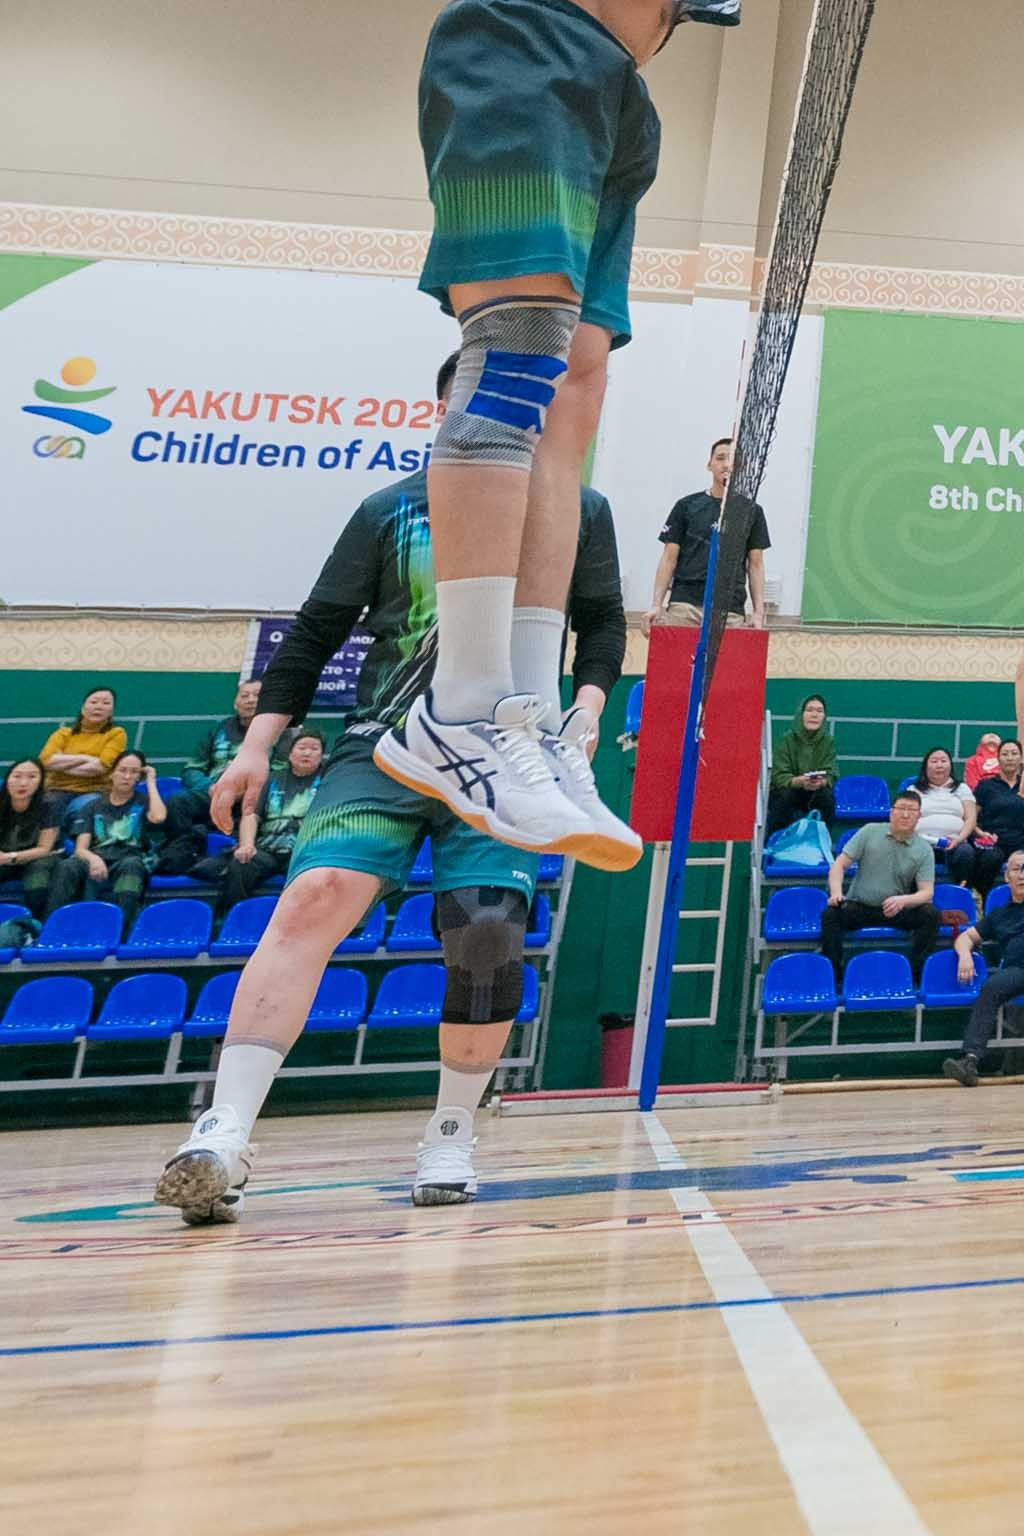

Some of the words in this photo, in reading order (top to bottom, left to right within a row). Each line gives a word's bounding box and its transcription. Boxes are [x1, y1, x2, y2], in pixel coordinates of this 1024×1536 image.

[147, 387, 347, 426] YAKUTSK
[354, 399, 446, 430] 202
[131, 431, 306, 470] Children
[318, 439, 361, 470] of
[367, 440, 431, 472] Asi
[929, 484, 979, 513] 8th
